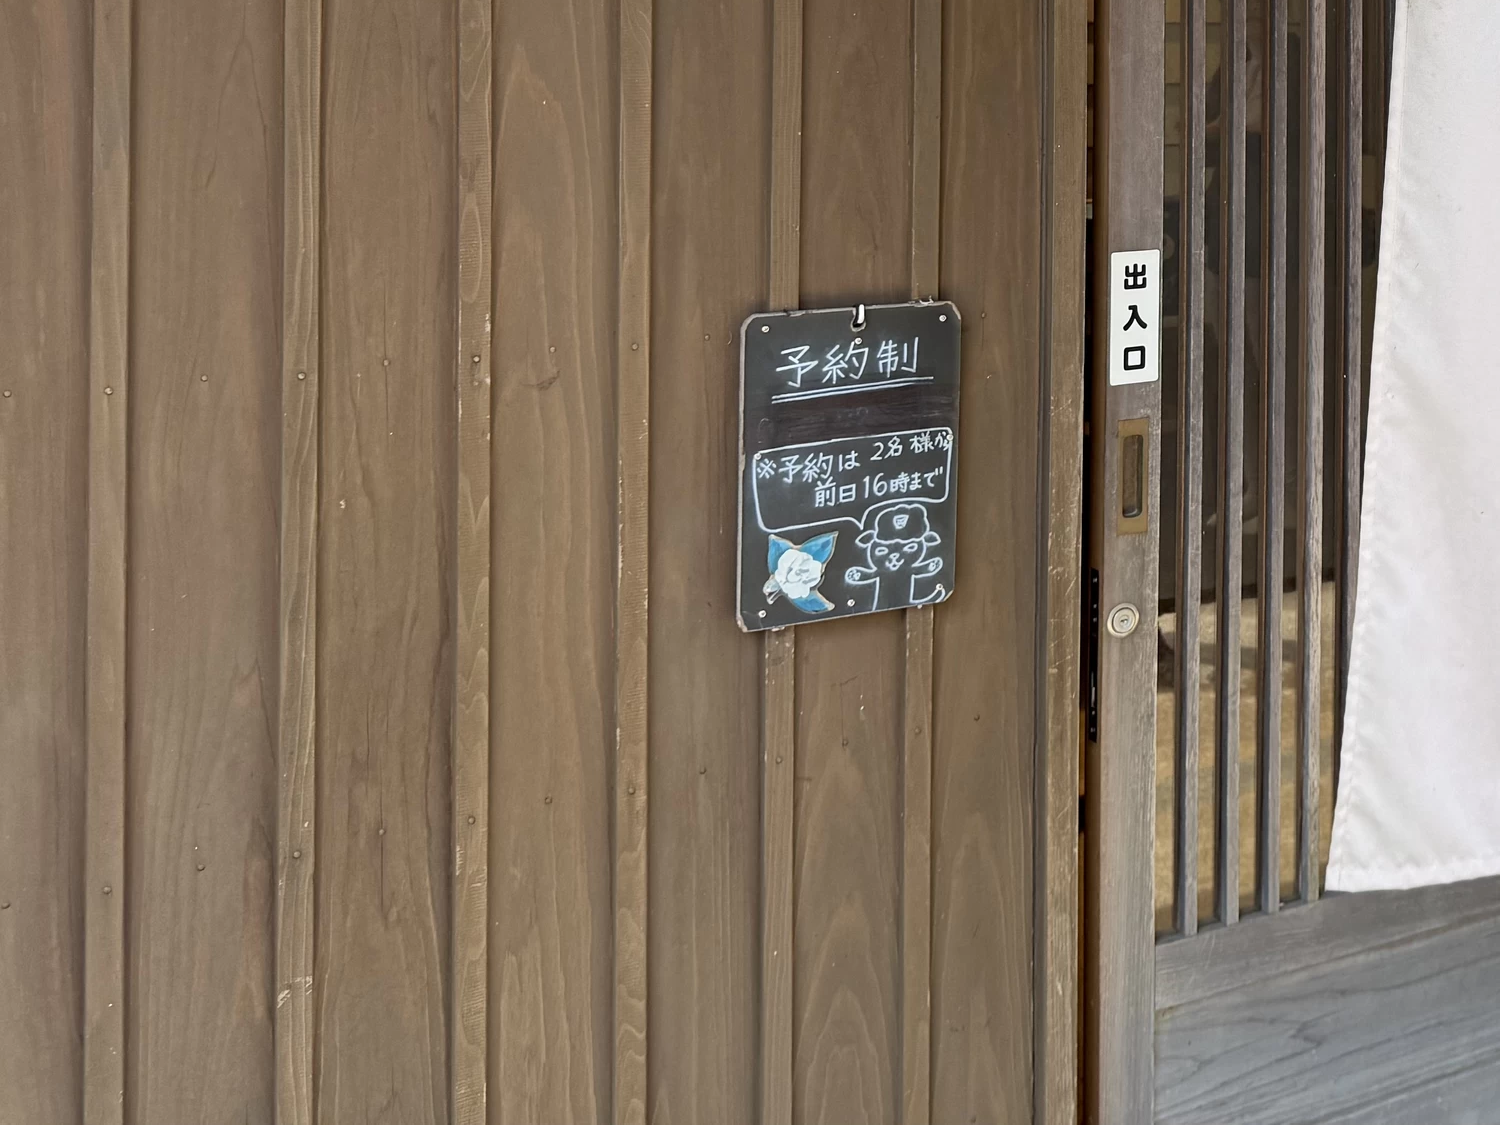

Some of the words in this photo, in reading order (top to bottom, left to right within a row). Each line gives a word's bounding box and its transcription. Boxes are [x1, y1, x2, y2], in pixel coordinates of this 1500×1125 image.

[1123, 263, 1148, 371] 出入口
[775, 336, 919, 388] 予約制
[815, 466, 944, 507] 前日16時まで
